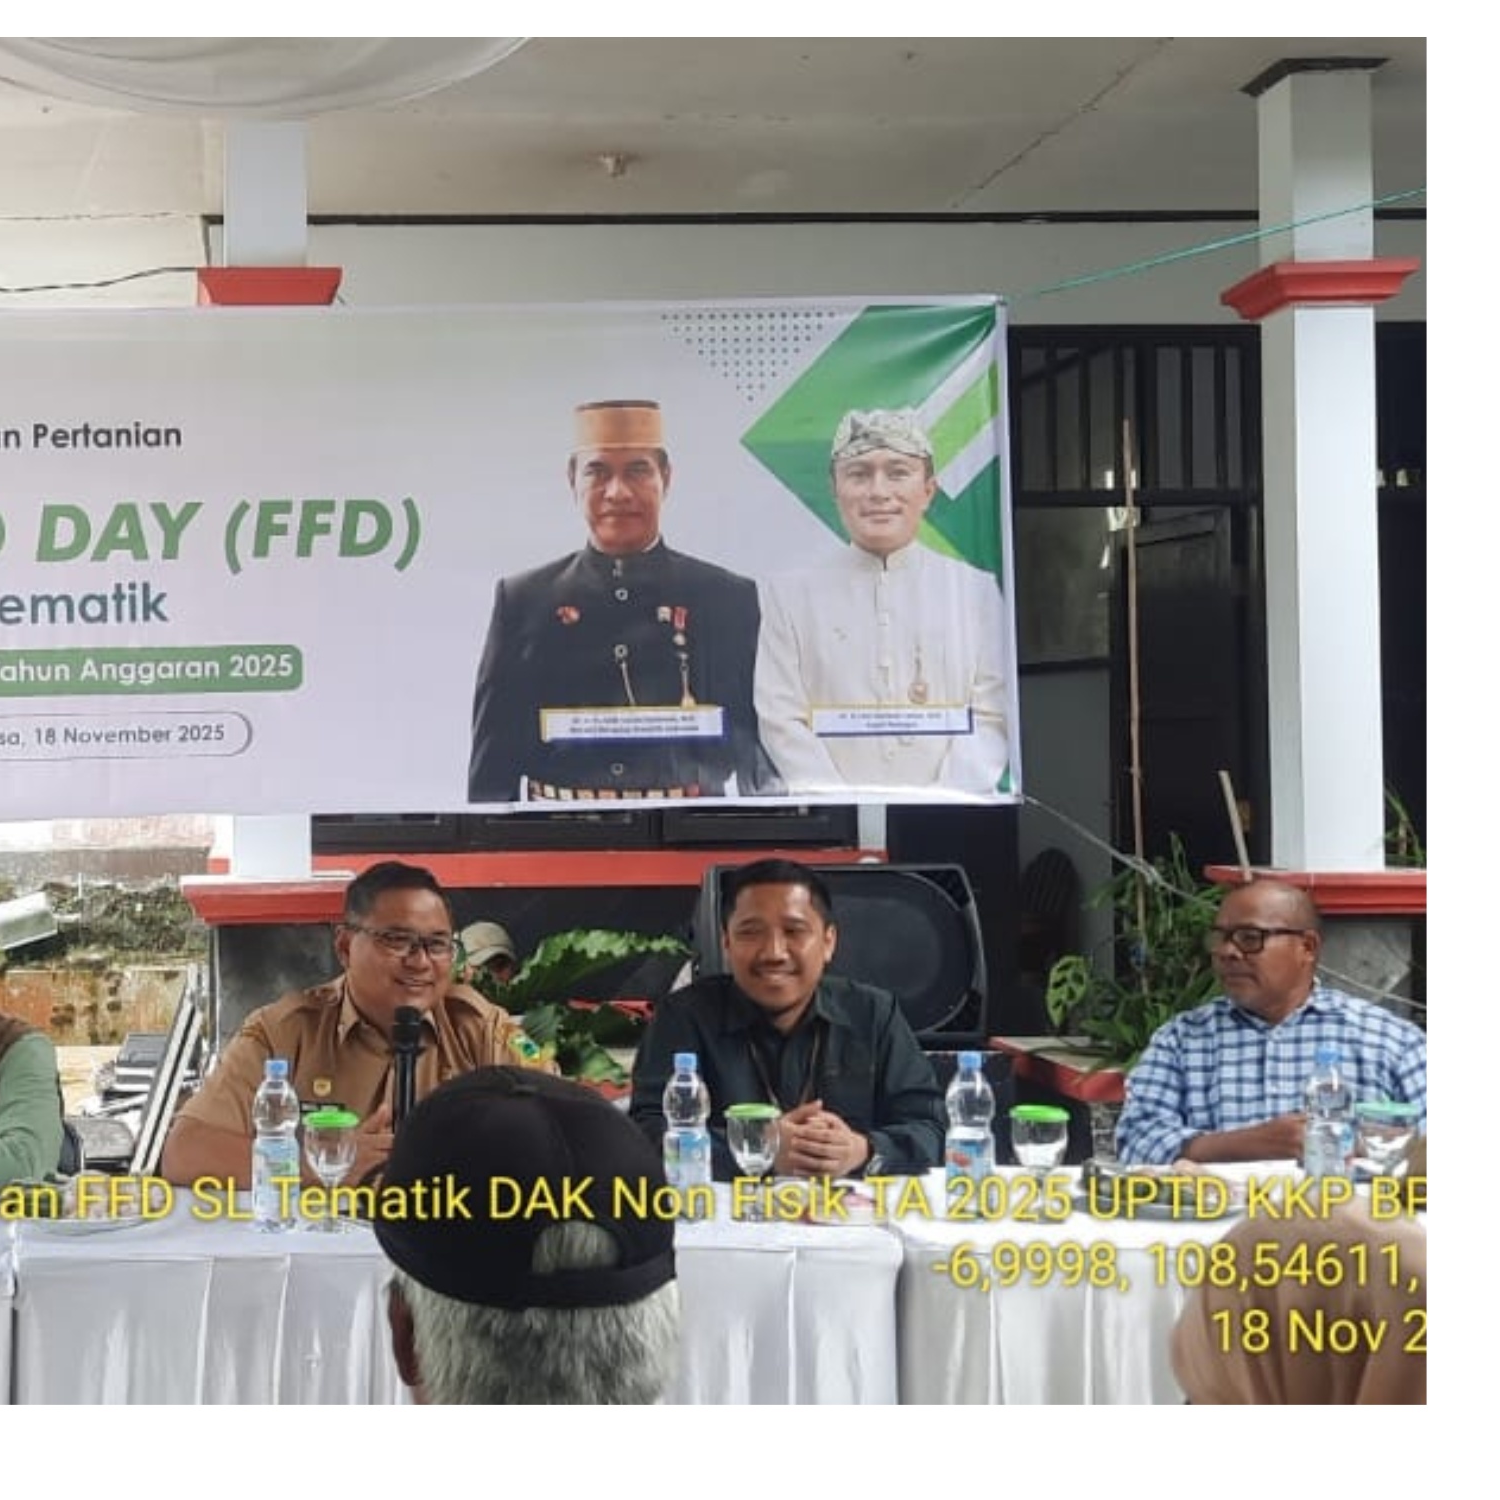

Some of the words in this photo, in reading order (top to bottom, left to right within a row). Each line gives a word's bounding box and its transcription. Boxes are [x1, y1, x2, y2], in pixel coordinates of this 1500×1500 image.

[32, 421, 182, 449] Pertanian
[36, 501, 204, 563] DAY
[224, 497, 422, 575] (FFD)
[80, 657, 220, 686] Anggaran
[229, 654, 294, 678] 2025
[34, 727, 57, 745] 18
[63, 725, 172, 745] November
[178, 724, 225, 743] 2025
